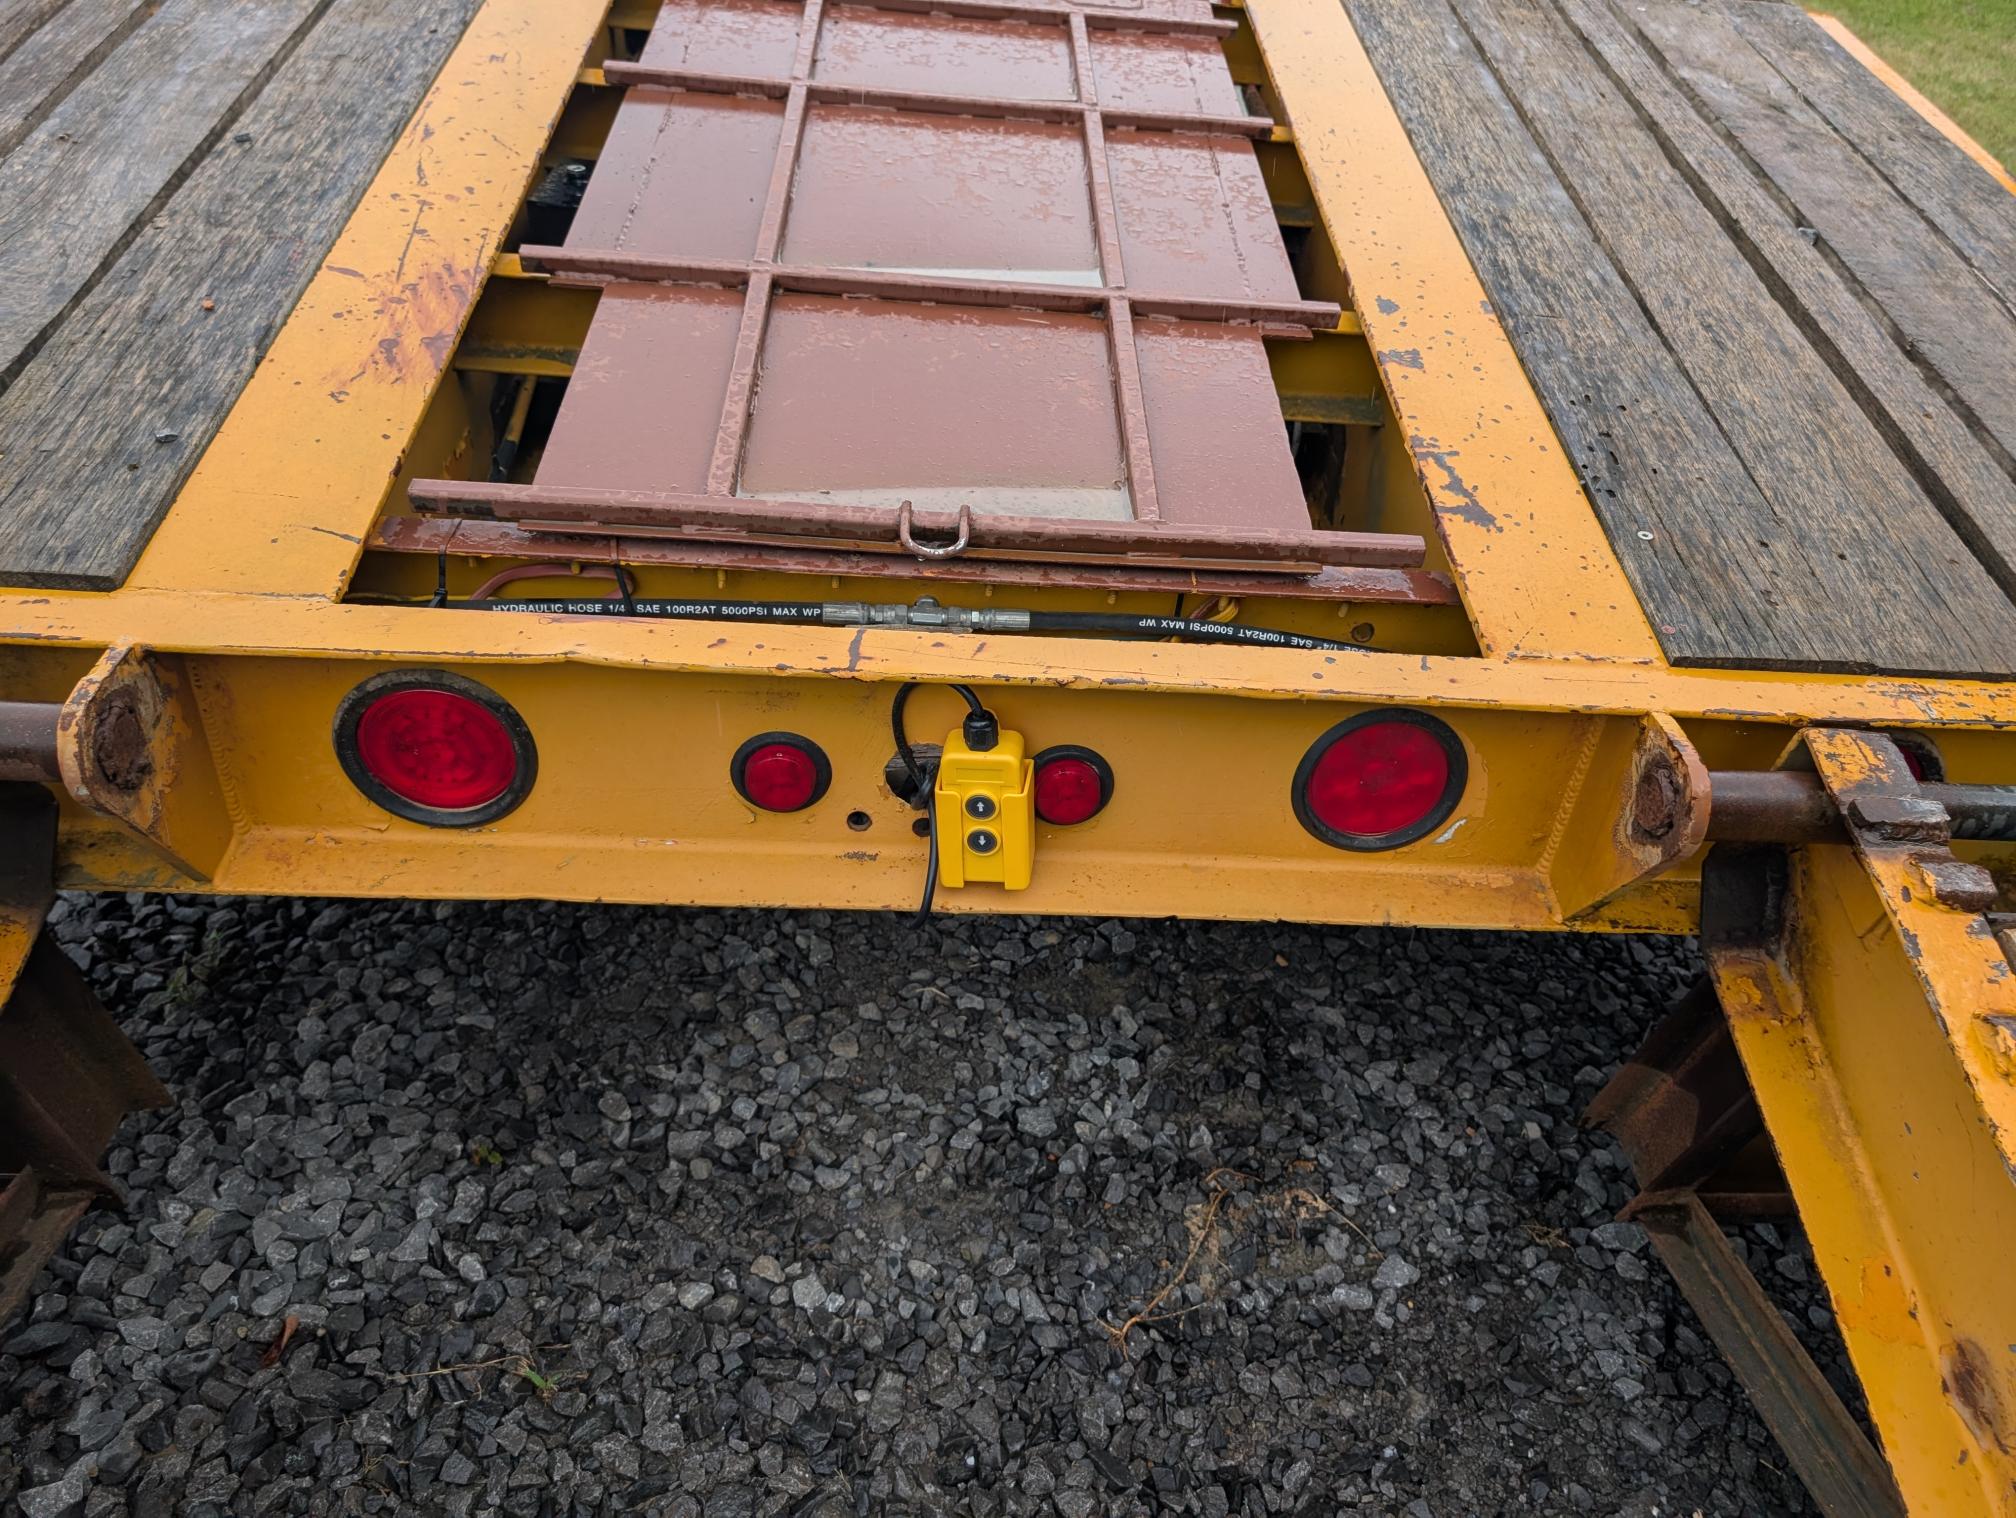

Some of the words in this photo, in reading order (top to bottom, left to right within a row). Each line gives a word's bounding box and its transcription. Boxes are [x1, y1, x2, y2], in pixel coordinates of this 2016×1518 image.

[493, 604, 563, 613] HYDRAULIC
[568, 604, 602, 613] HOSE
[636, 604, 660, 613] SAE
[666, 605, 717, 614] 100R2AT
[721, 606, 767, 616] 5000PSI
[773, 607, 798, 616] MAX
[803, 608, 821, 617] WP
[1139, 618, 1156, 627] WP
[1161, 619, 1185, 630] MAX
[1190, 622, 1234, 635] 5000PSI
[1238, 630, 1285, 643] 100R2AT
[1291, 636, 1313, 648] SAE
